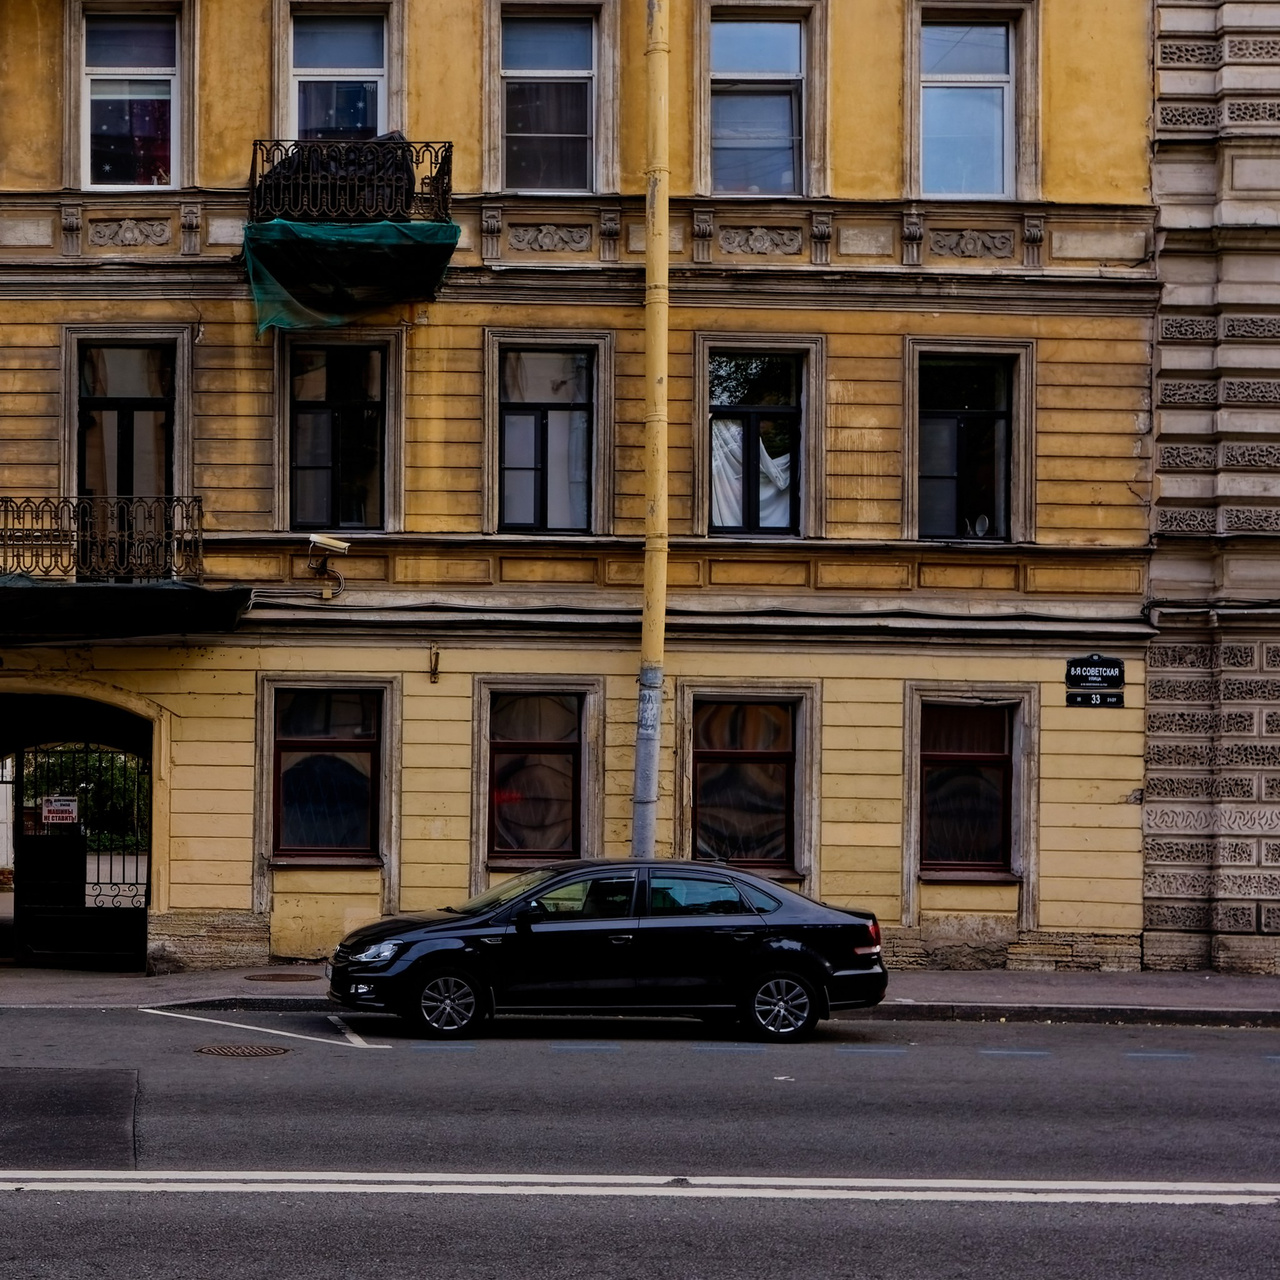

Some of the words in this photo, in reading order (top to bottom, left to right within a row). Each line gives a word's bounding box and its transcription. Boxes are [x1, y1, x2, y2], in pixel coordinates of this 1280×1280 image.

[1071, 667, 1081, 676] 8-Я
[1082, 667, 1119, 676] СОВЕТСКАЯ
[1091, 694, 1101, 704] 33
